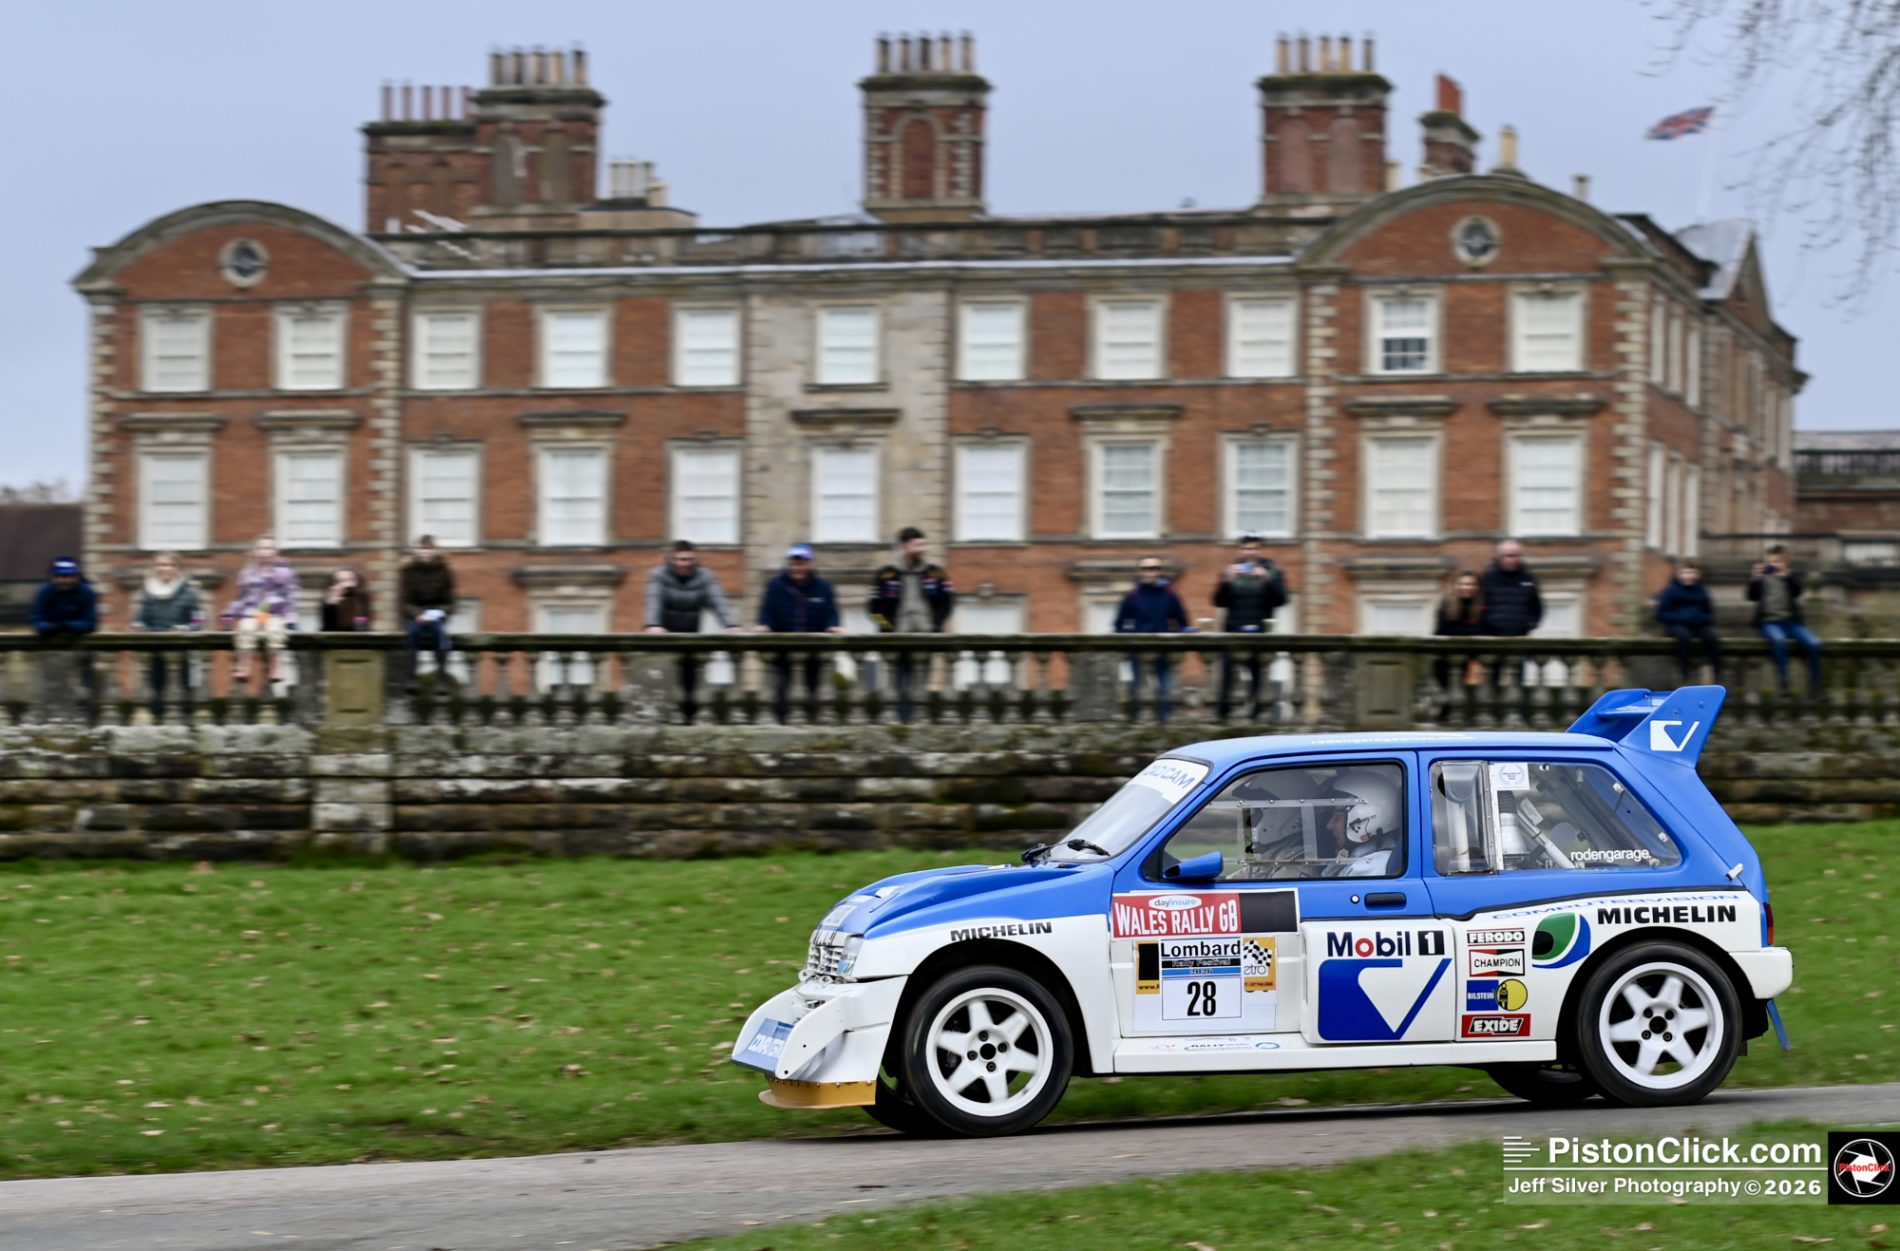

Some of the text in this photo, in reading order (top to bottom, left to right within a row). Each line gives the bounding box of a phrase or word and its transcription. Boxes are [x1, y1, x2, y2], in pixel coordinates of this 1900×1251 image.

[1114, 899, 1238, 936] WALES RALLY GB
[1598, 905, 1737, 924] MICHELIN
[950, 922, 1052, 941] MICHELIN
[1468, 931, 1523, 944] FERODO
[1161, 940, 1241, 958] Lombard
[1326, 931, 1412, 957] Mobil
[1474, 958, 1520, 968] CHAMPION
[1186, 980, 1217, 1017] 28
[1467, 992, 1495, 1000] BILSTEIN
[1473, 1019, 1519, 1033] EXIDE
